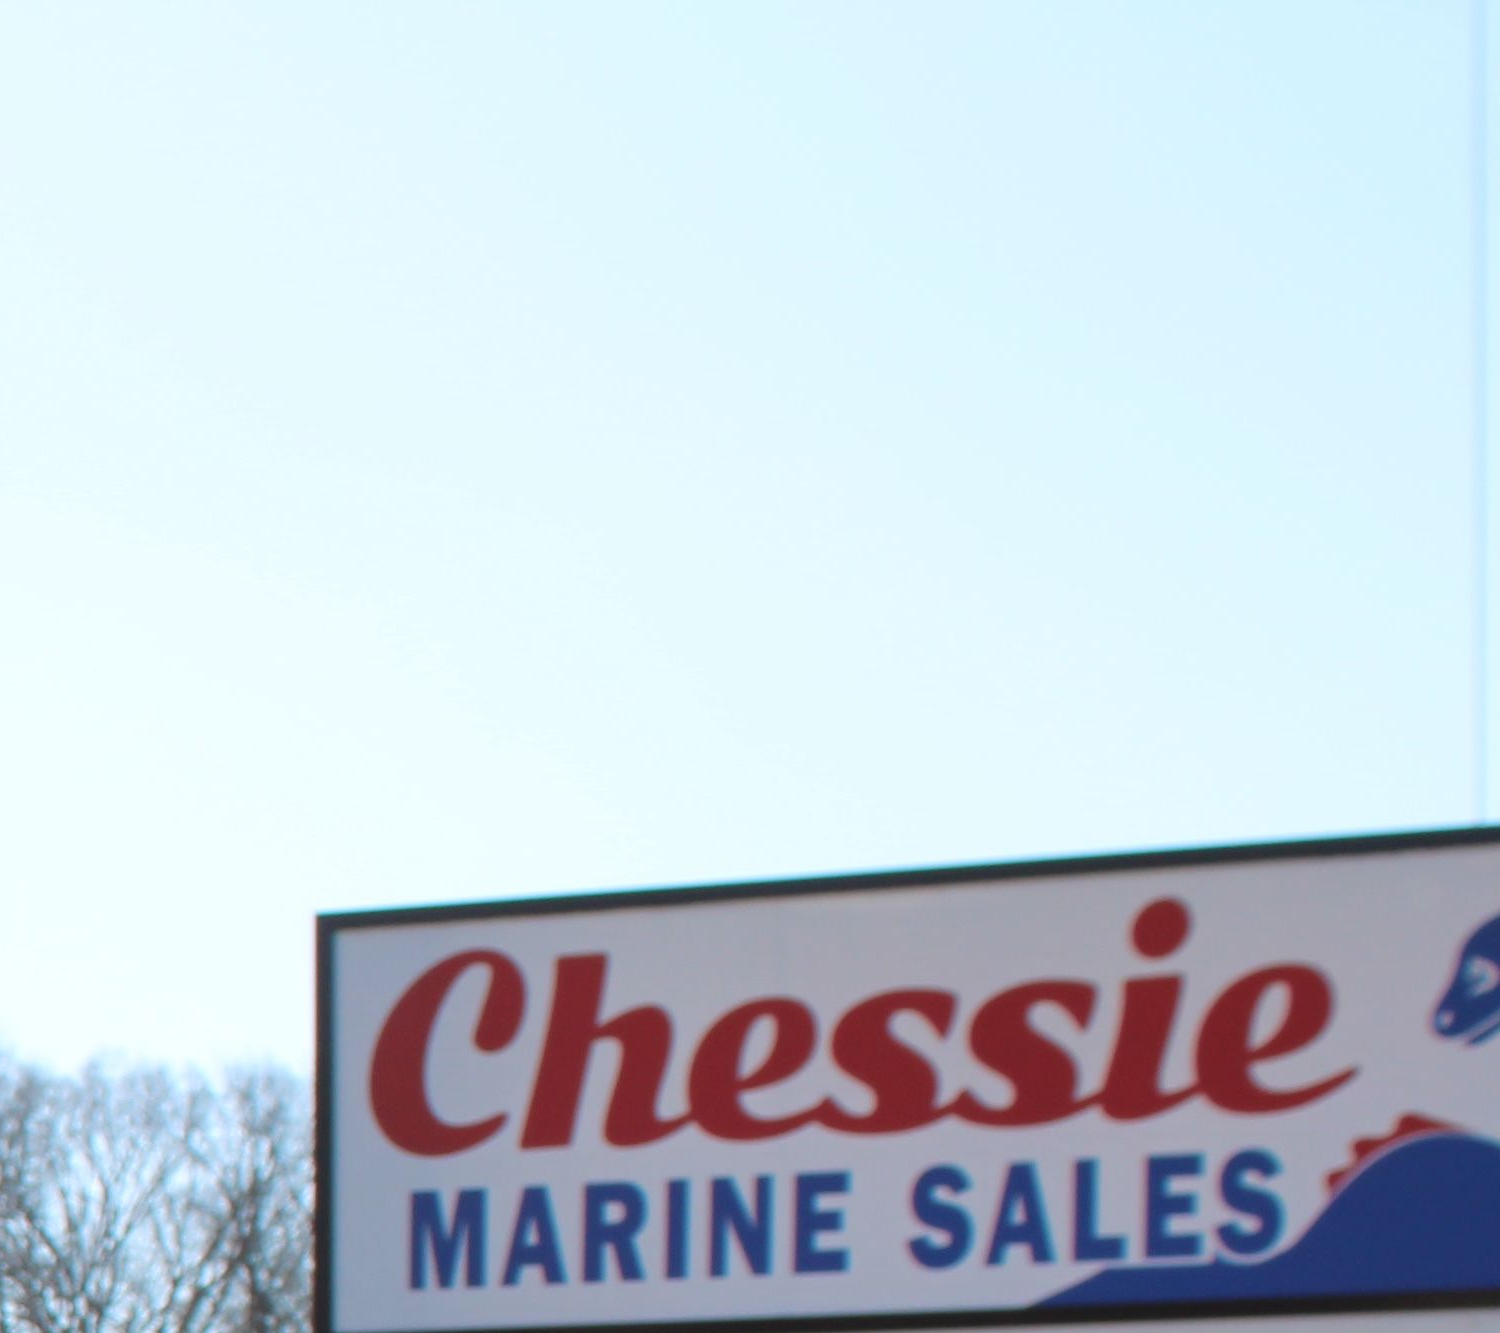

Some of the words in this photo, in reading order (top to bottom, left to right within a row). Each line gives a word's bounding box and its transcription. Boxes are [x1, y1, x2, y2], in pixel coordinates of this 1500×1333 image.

[367, 895, 1363, 1158] Chessie
[408, 1169, 853, 1294] MARINE
[907, 1147, 1287, 1272] SALES
